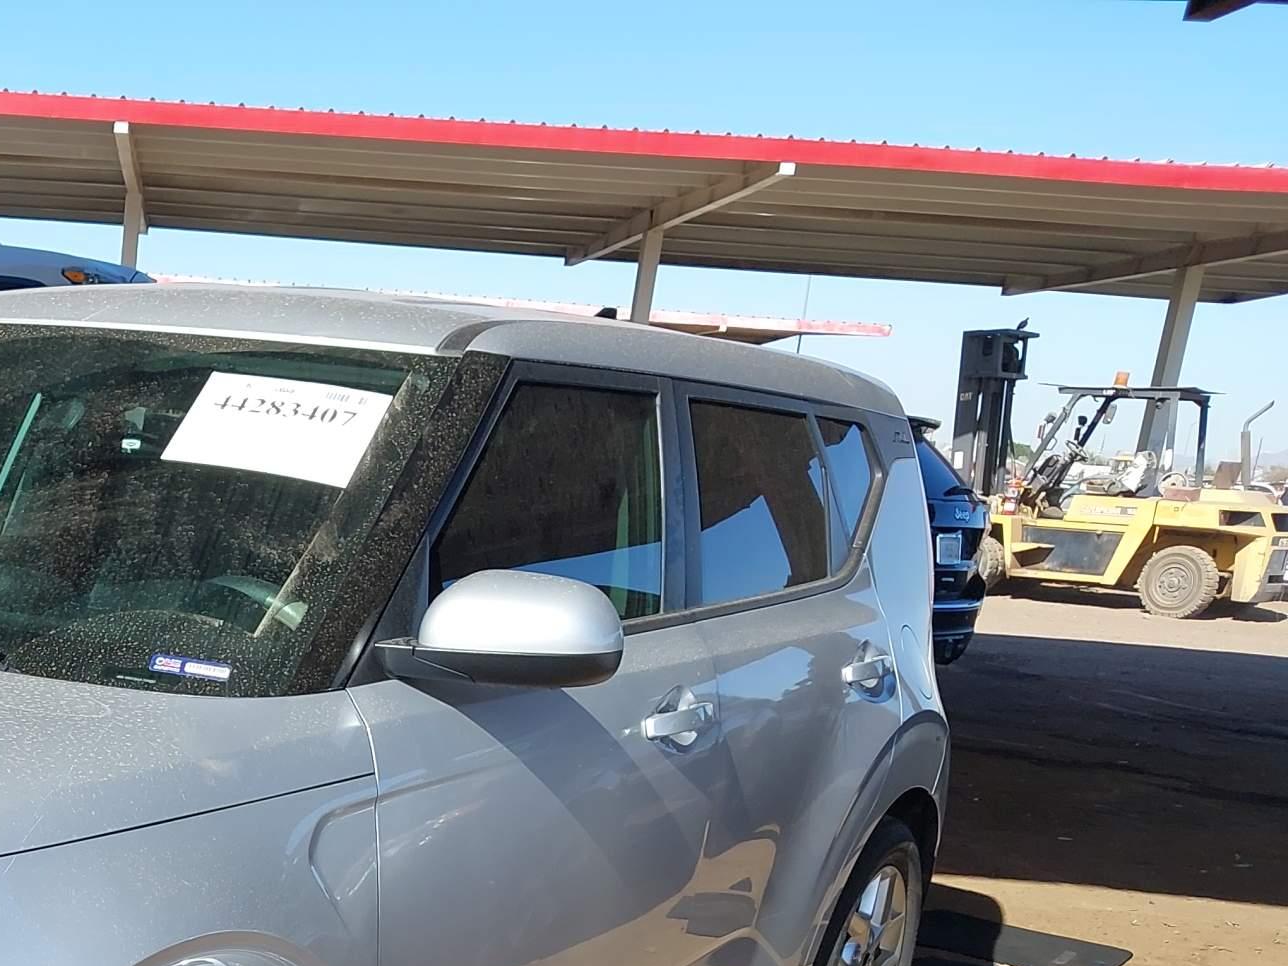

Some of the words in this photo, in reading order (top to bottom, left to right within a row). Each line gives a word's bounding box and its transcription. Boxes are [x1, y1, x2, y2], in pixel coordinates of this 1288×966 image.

[959, 391, 973, 401] CAT
[214, 395, 357, 426] 44283407
[954, 506, 970, 523] Jeep
